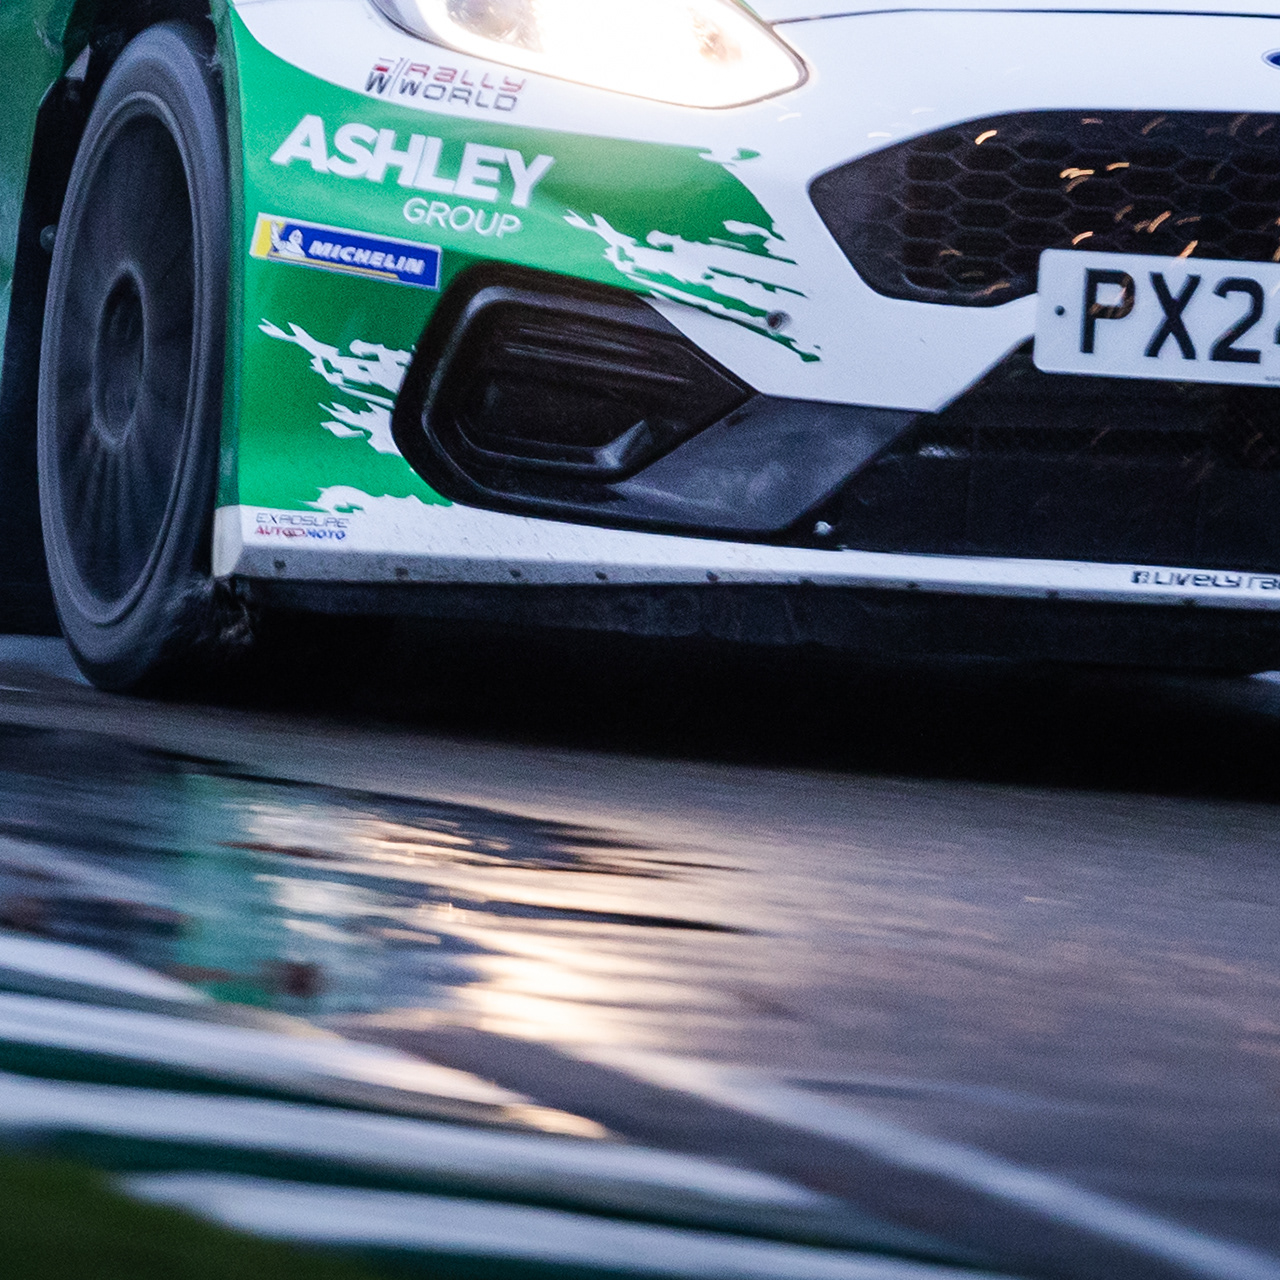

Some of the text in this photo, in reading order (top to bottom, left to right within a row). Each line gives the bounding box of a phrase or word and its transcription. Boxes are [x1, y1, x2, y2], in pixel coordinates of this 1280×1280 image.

[270, 114, 555, 208] ASHLEY
[402, 196, 521, 240] GROUP
[307, 239, 426, 276] MICHELIN
[255, 512, 350, 529] EXPOSURE
